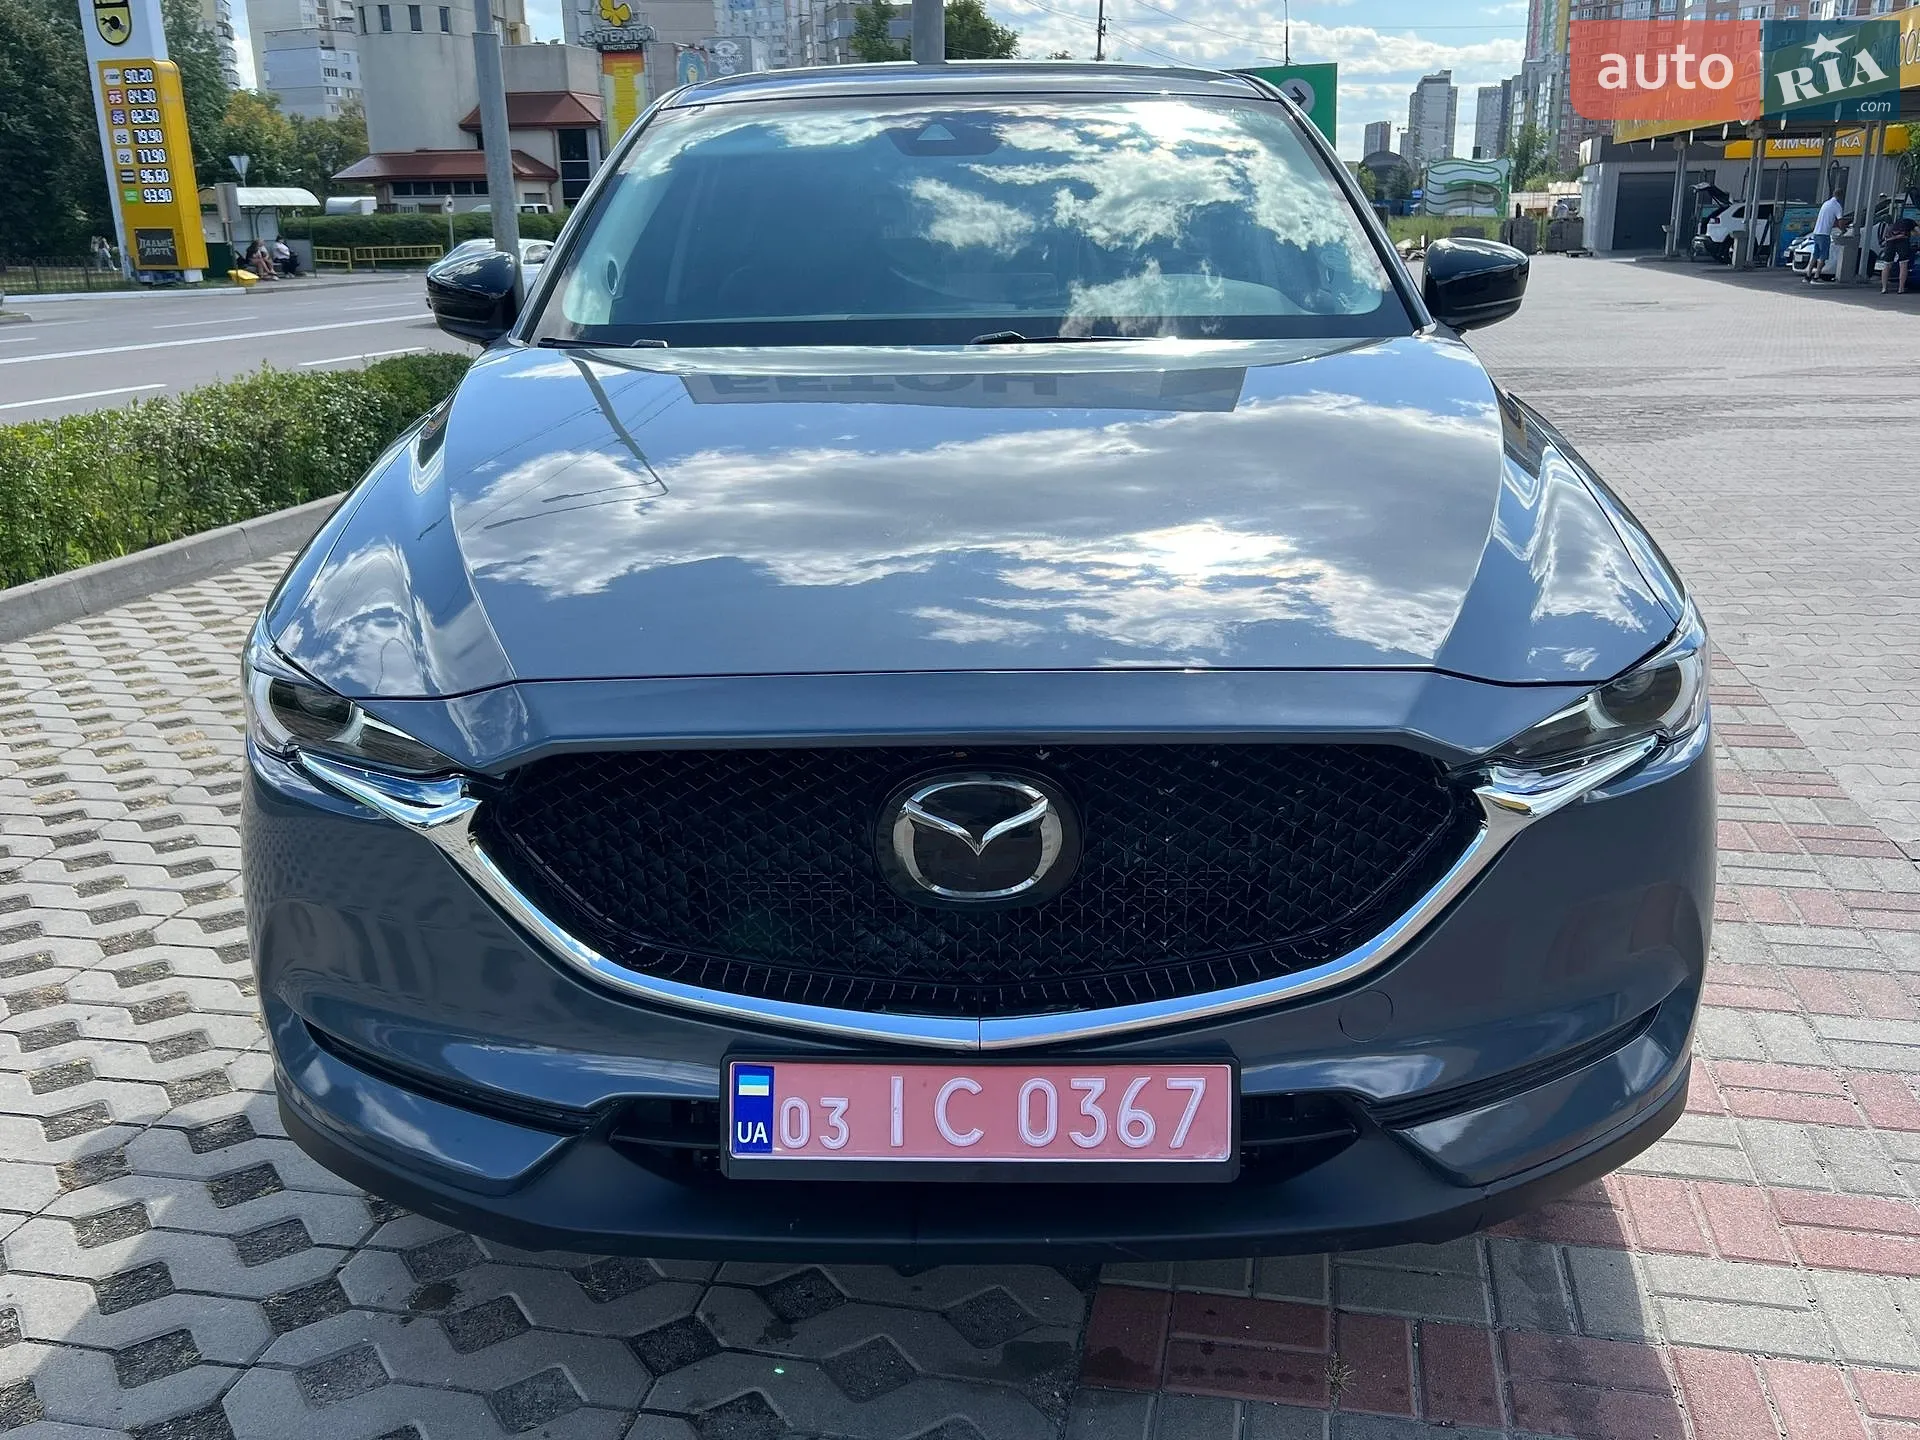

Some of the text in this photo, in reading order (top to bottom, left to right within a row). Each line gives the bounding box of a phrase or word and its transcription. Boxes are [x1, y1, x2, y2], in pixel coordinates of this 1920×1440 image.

[109, 95, 122, 104] 95
[116, 129, 164, 144] 95 79.90
[1772, 136, 1861, 150] ХІМЧИКА
[119, 149, 167, 163] 92 77.90
[143, 189, 173, 203] 93.90
[778, 1096, 850, 1150] 03
[1017, 1075, 1207, 1149] 0367
[737, 1121, 769, 1145] UA
